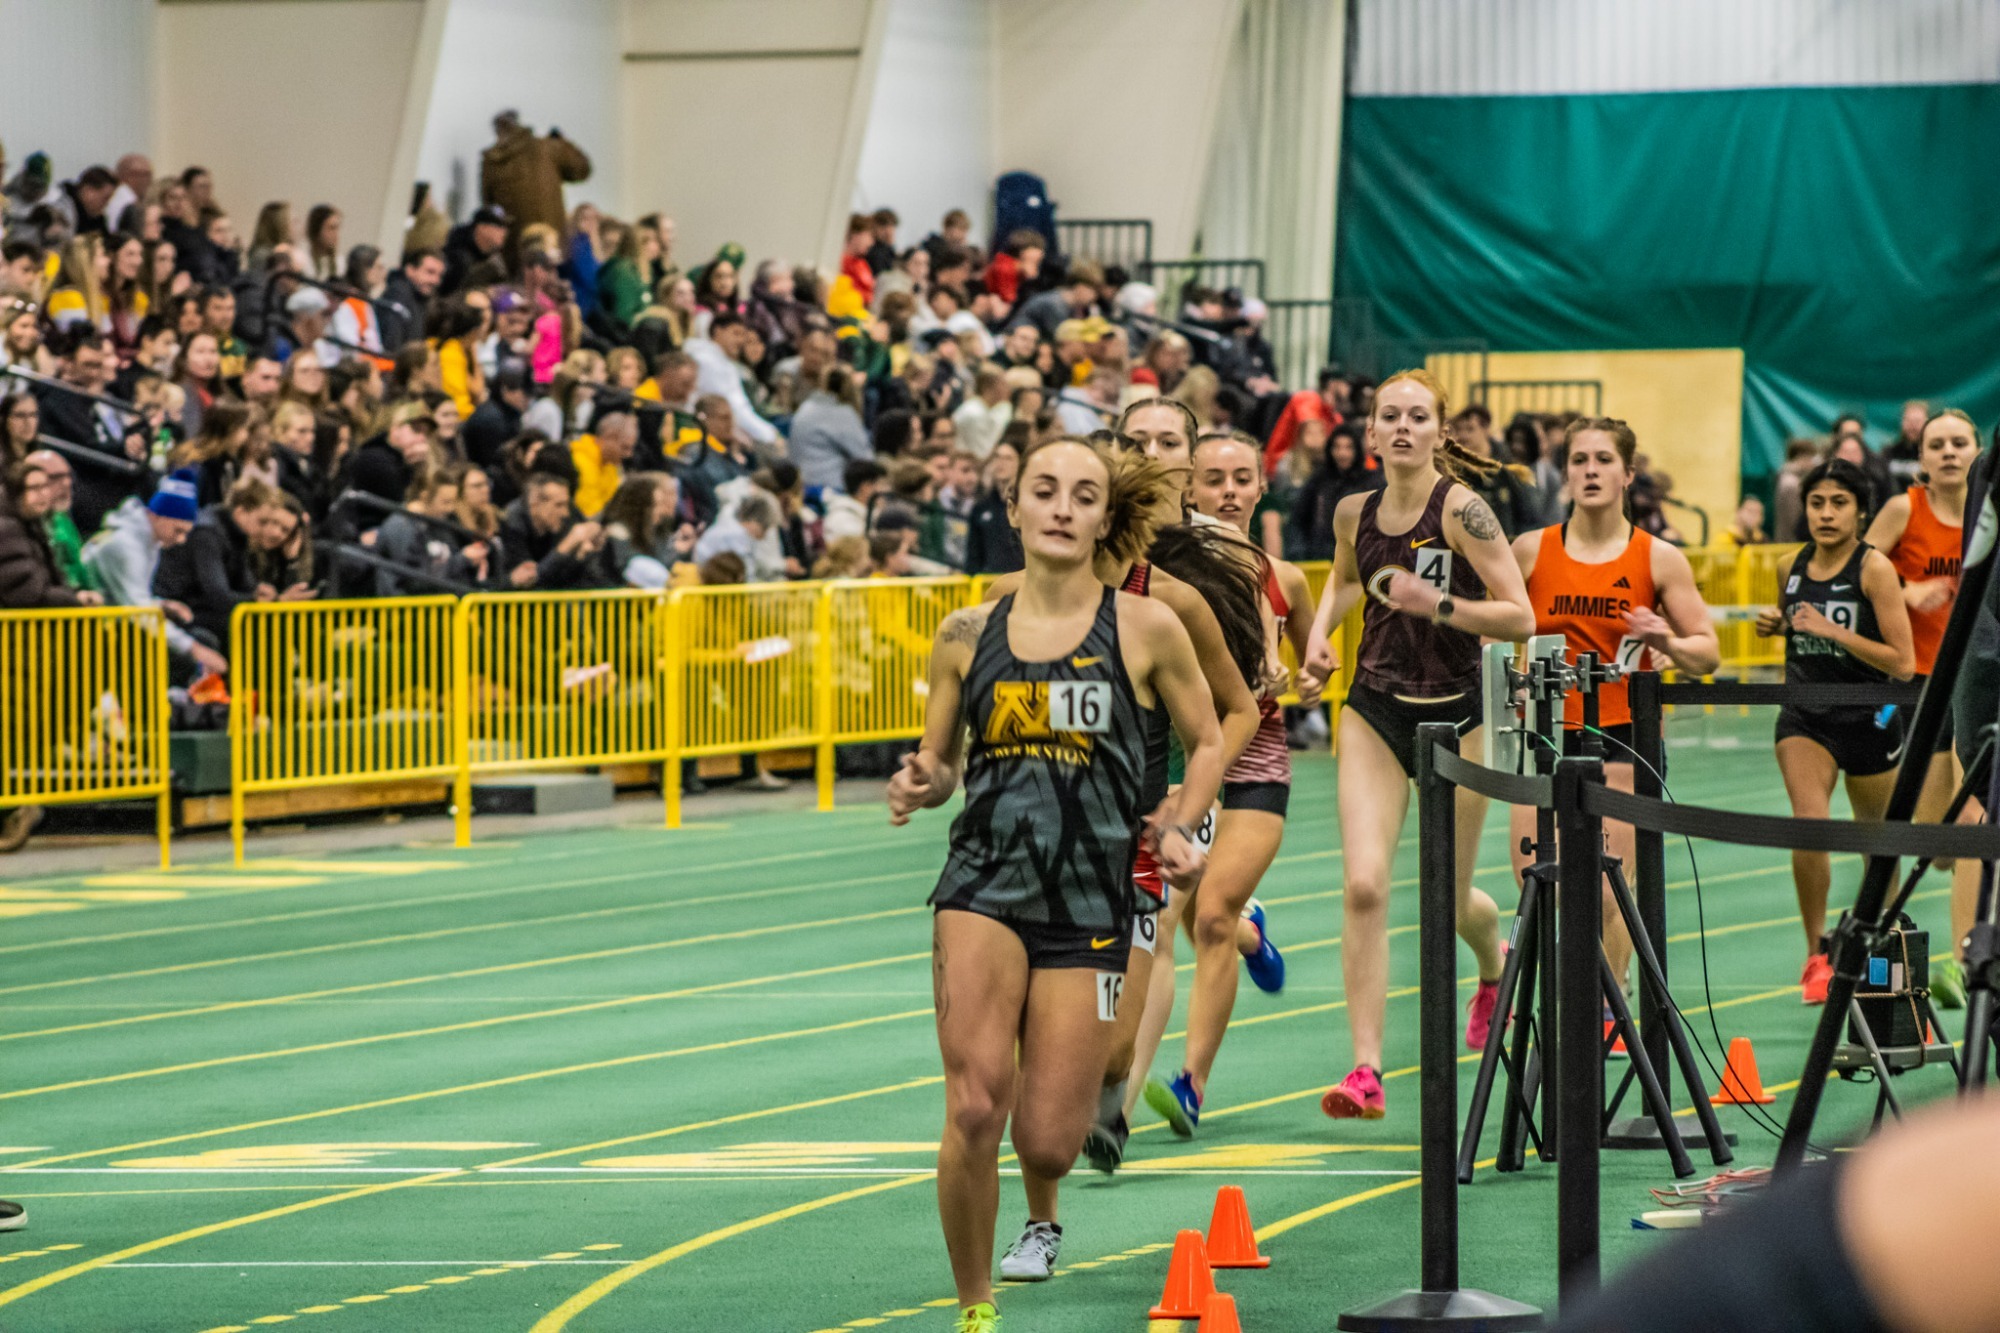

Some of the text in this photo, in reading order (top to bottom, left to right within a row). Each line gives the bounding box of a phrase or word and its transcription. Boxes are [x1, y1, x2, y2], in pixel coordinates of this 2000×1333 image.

[1421, 554, 1446, 588] 4
[1548, 594, 1631, 620] JIMMIES
[1832, 606, 1851, 630] 9
[1624, 639, 1645, 666] 7
[1061, 686, 1100, 726] 16
[1197, 812, 1213, 845] 8
[1138, 914, 1155, 943] 6
